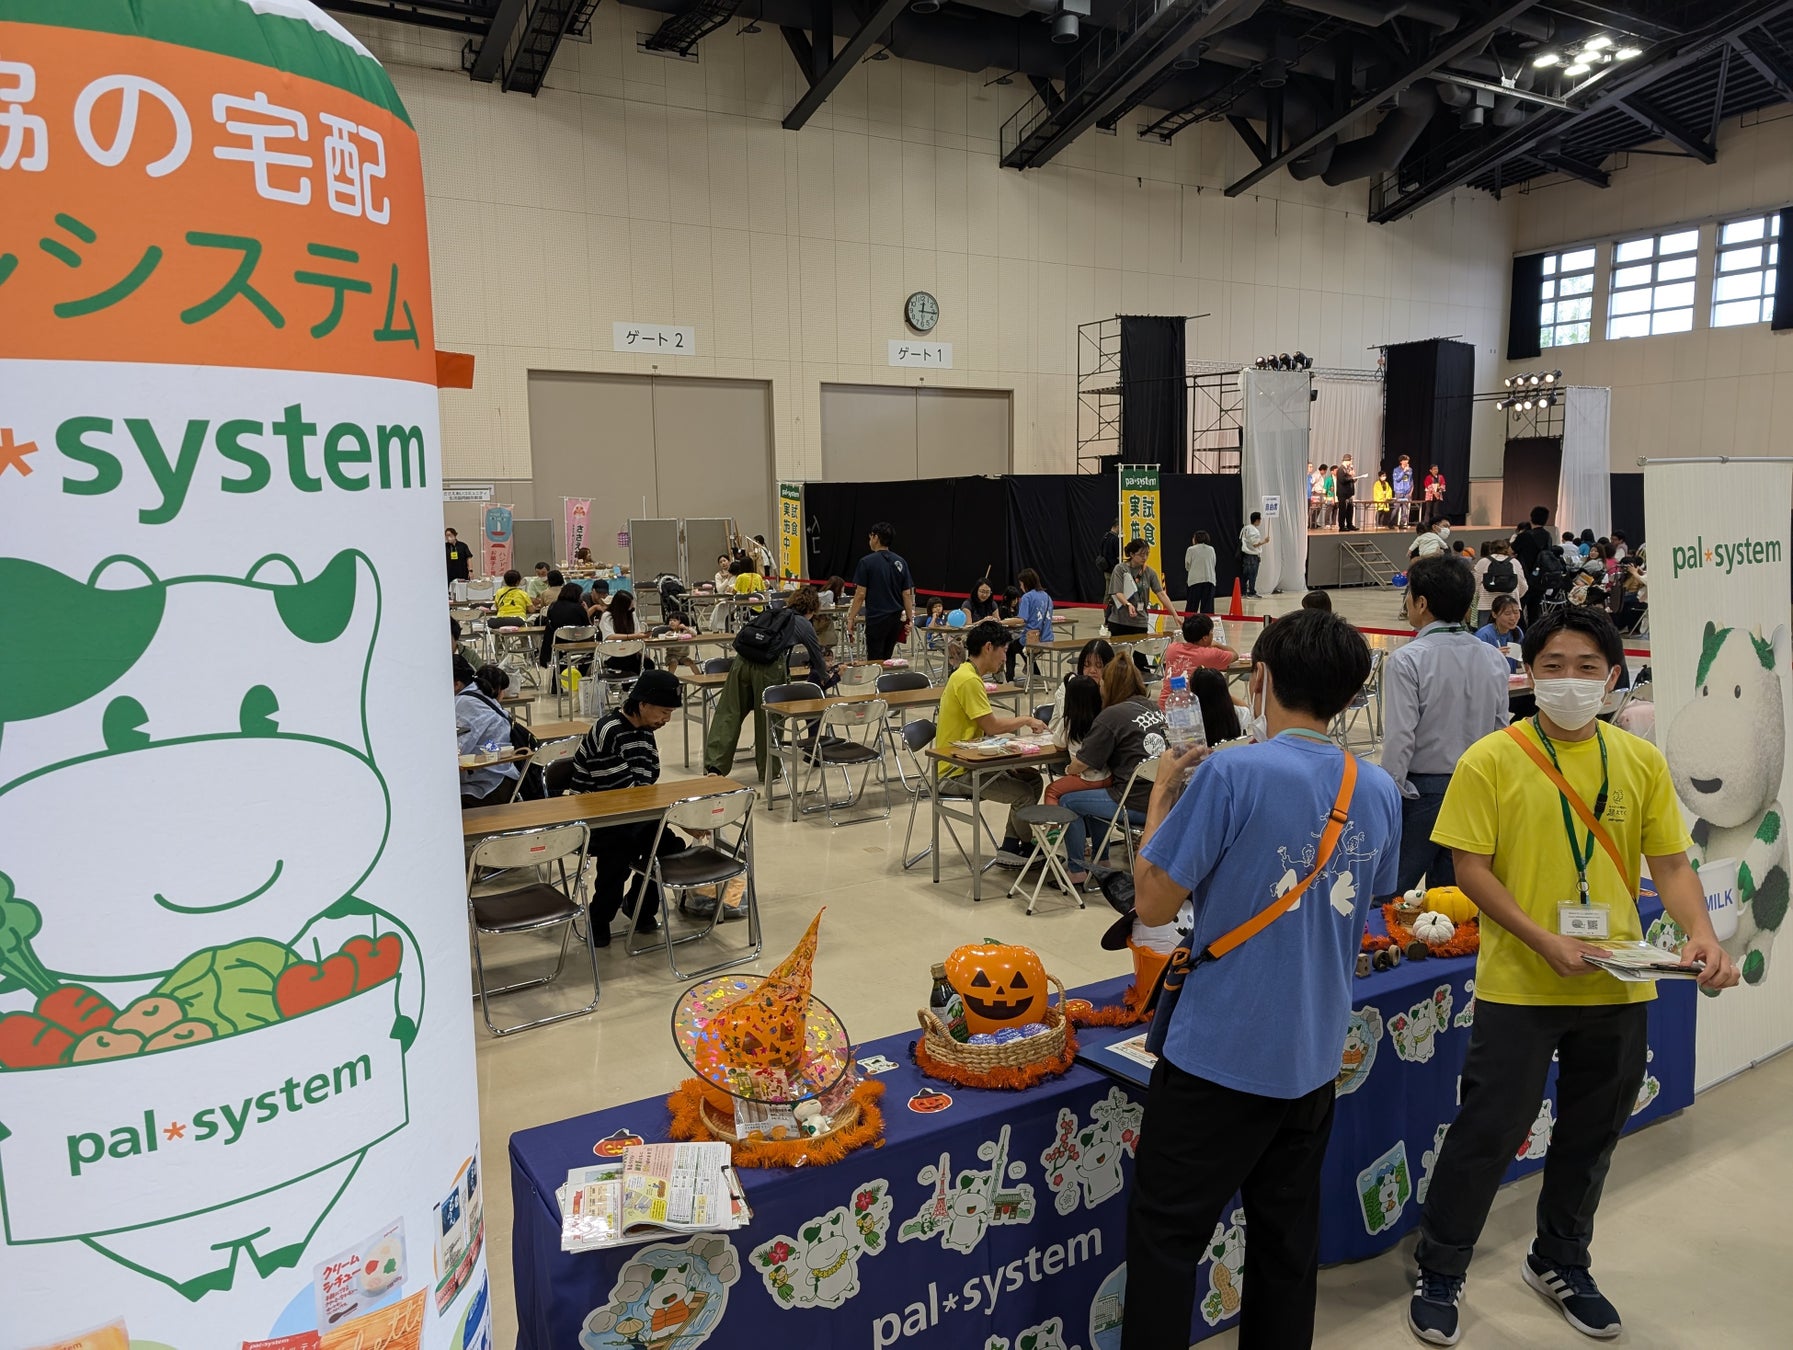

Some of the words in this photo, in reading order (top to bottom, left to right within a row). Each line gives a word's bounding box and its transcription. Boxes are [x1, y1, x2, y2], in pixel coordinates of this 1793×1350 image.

[0, 212, 421, 350] システム
[626, 330, 668, 348] ゲート
[675, 332, 684, 349] 2
[898, 346, 932, 362] ゲート
[936, 348, 943, 362] 1
[791, 504, 798, 536] 試食
[1142, 496, 1155, 546] 試食
[1704, 888, 1733, 912] MILK
[322, 1254, 360, 1280] クリーム
[322, 1268, 362, 1293] シチュー
